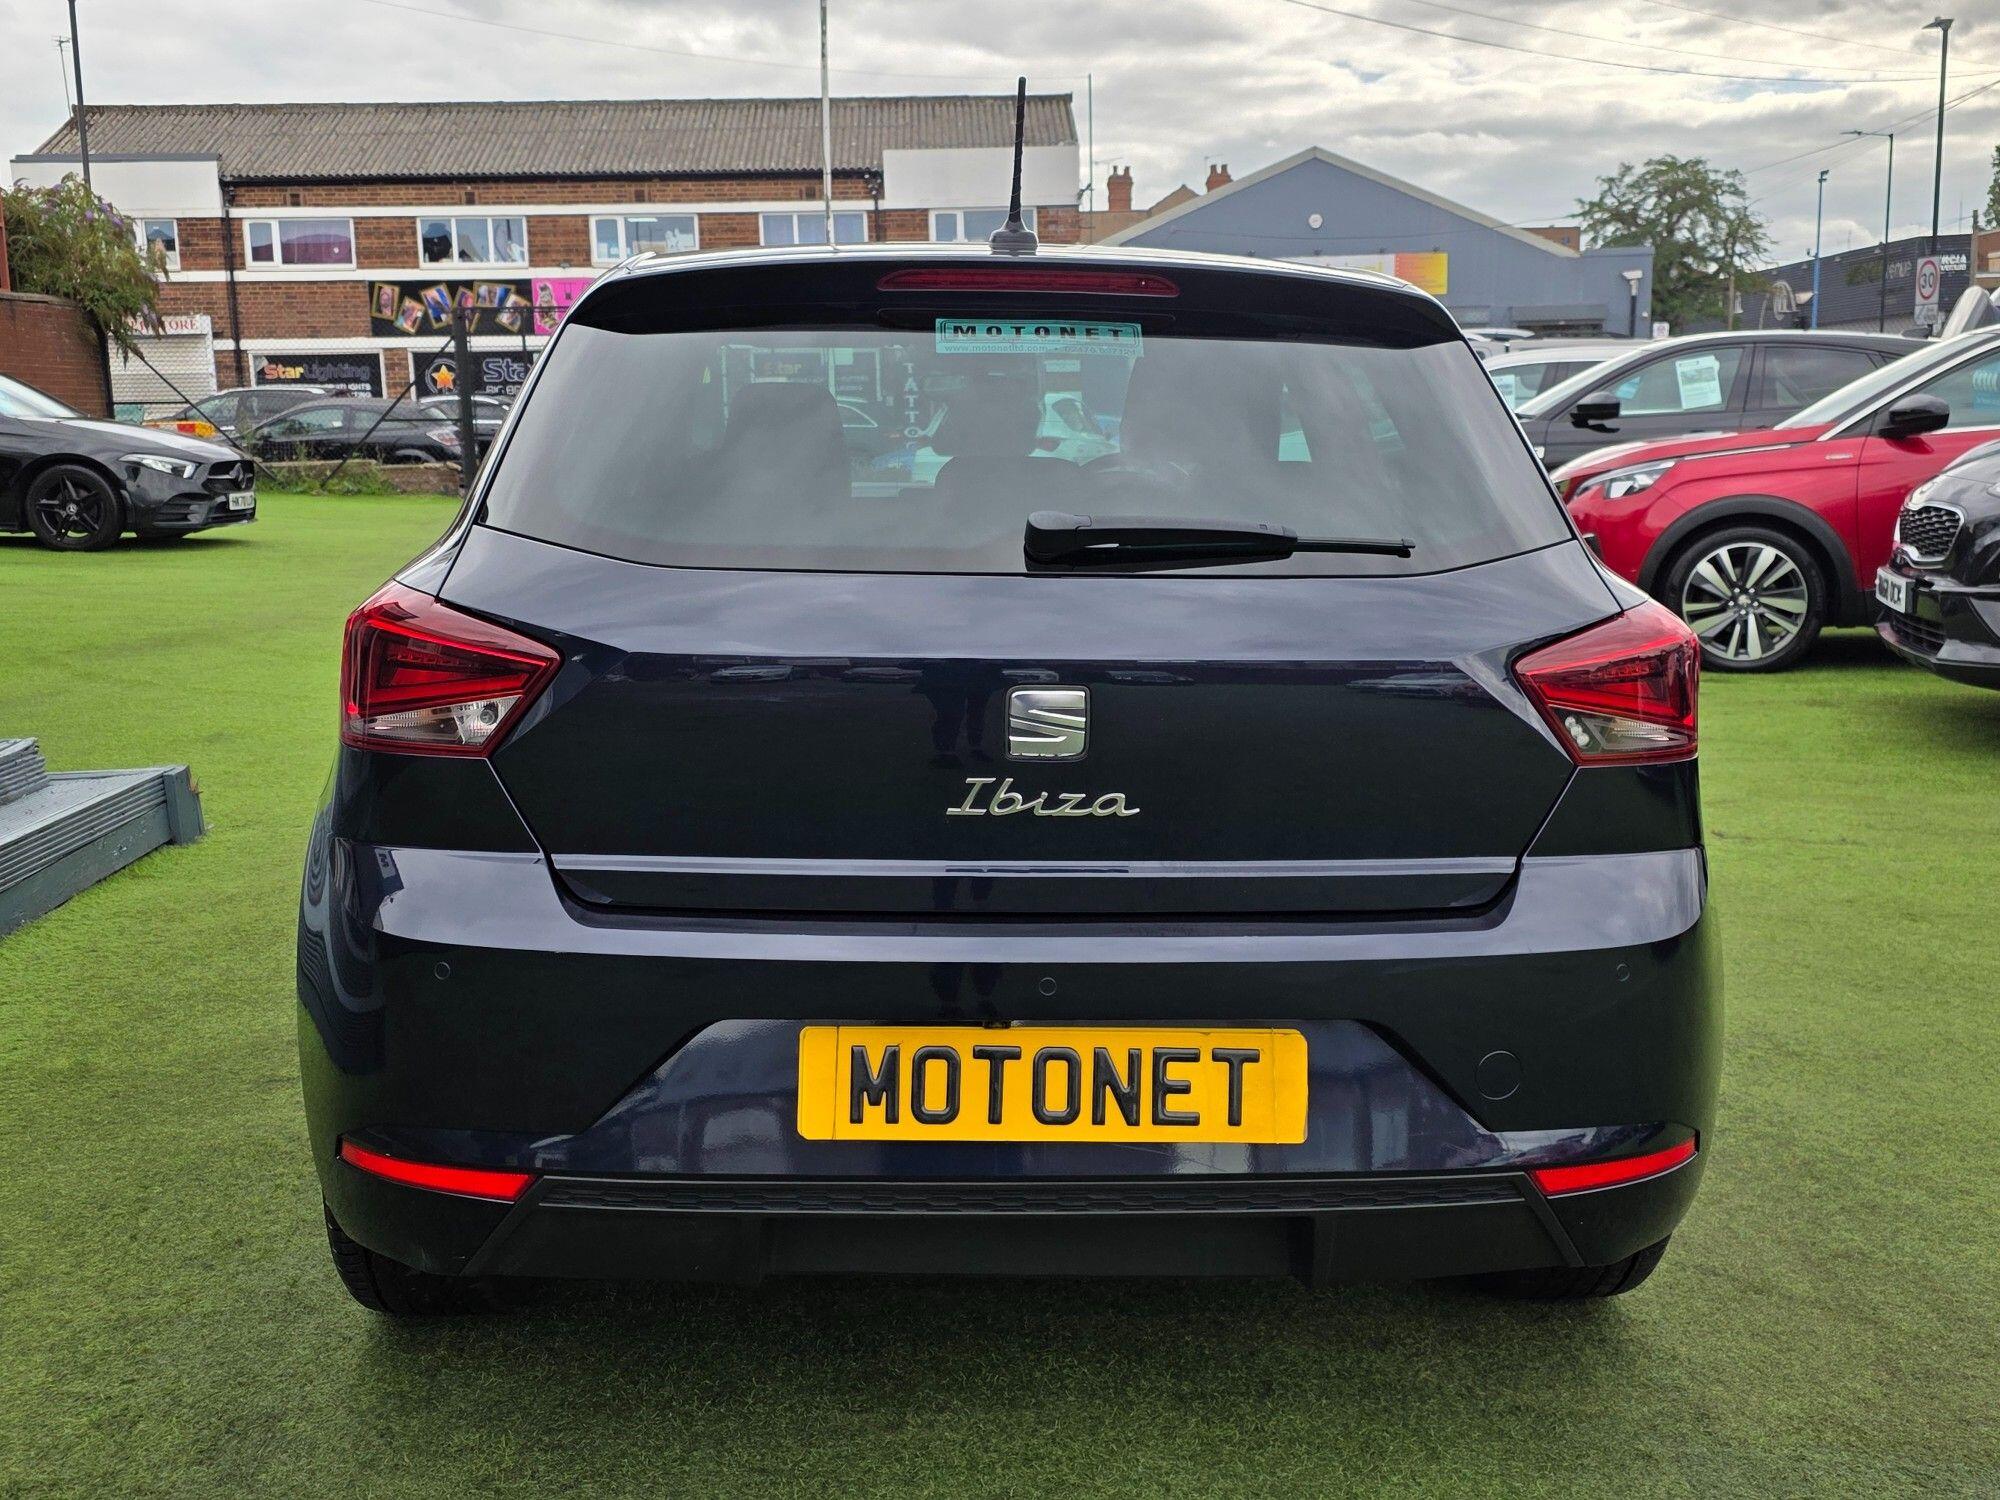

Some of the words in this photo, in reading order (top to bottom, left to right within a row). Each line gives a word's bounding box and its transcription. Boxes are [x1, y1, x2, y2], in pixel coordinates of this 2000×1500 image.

[1920, 272, 1935, 289] 30
[952, 325, 1123, 339] MOTONET
[264, 364, 304, 380] Star
[946, 777, 1140, 817] Ibiza
[849, 1045, 1260, 1127] MOTONET
